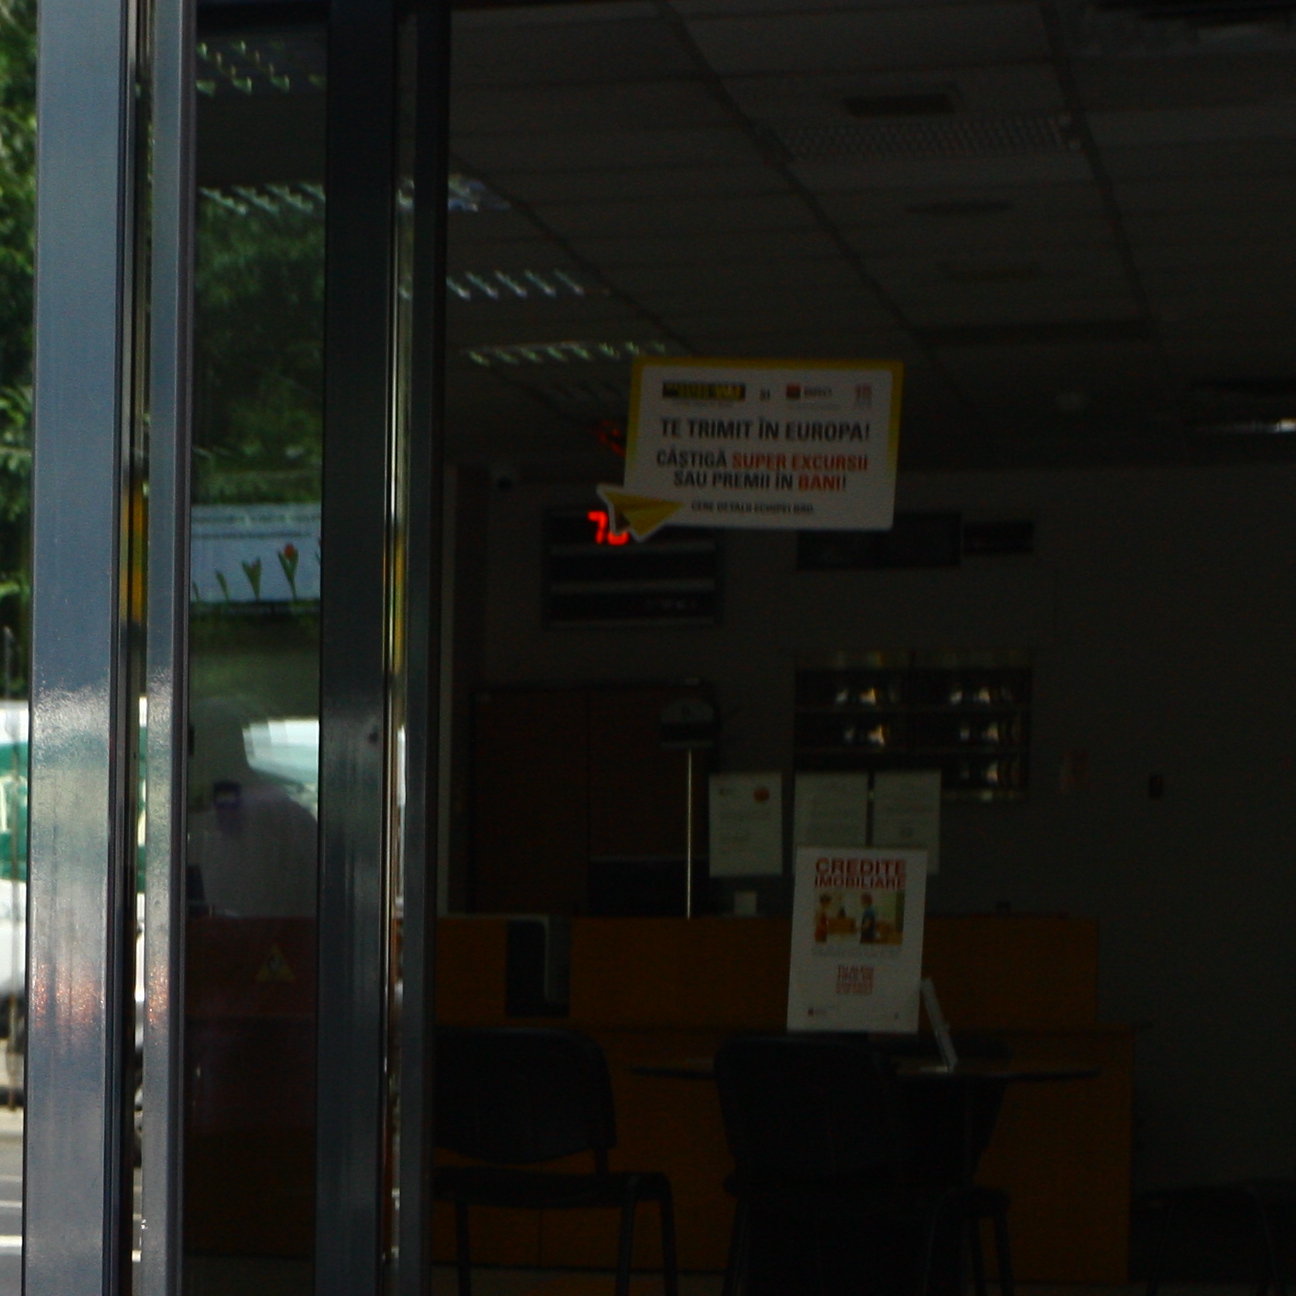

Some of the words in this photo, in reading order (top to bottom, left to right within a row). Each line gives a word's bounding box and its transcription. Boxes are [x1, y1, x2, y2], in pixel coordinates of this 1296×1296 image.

[660, 417, 681, 438] TE
[687, 418, 752, 440] TRIMIT
[758, 414, 780, 440] ÎN
[785, 420, 870, 442] EUROPA!
[731, 452, 786, 470] SUPER
[791, 453, 869, 472] EXCURSII
[673, 469, 707, 488] SAU
[712, 470, 770, 490] PREMII
[798, 474, 846, 492] BANI!
[814, 857, 907, 876] CREDITE
[813, 874, 907, 891] IMOBILIARE
